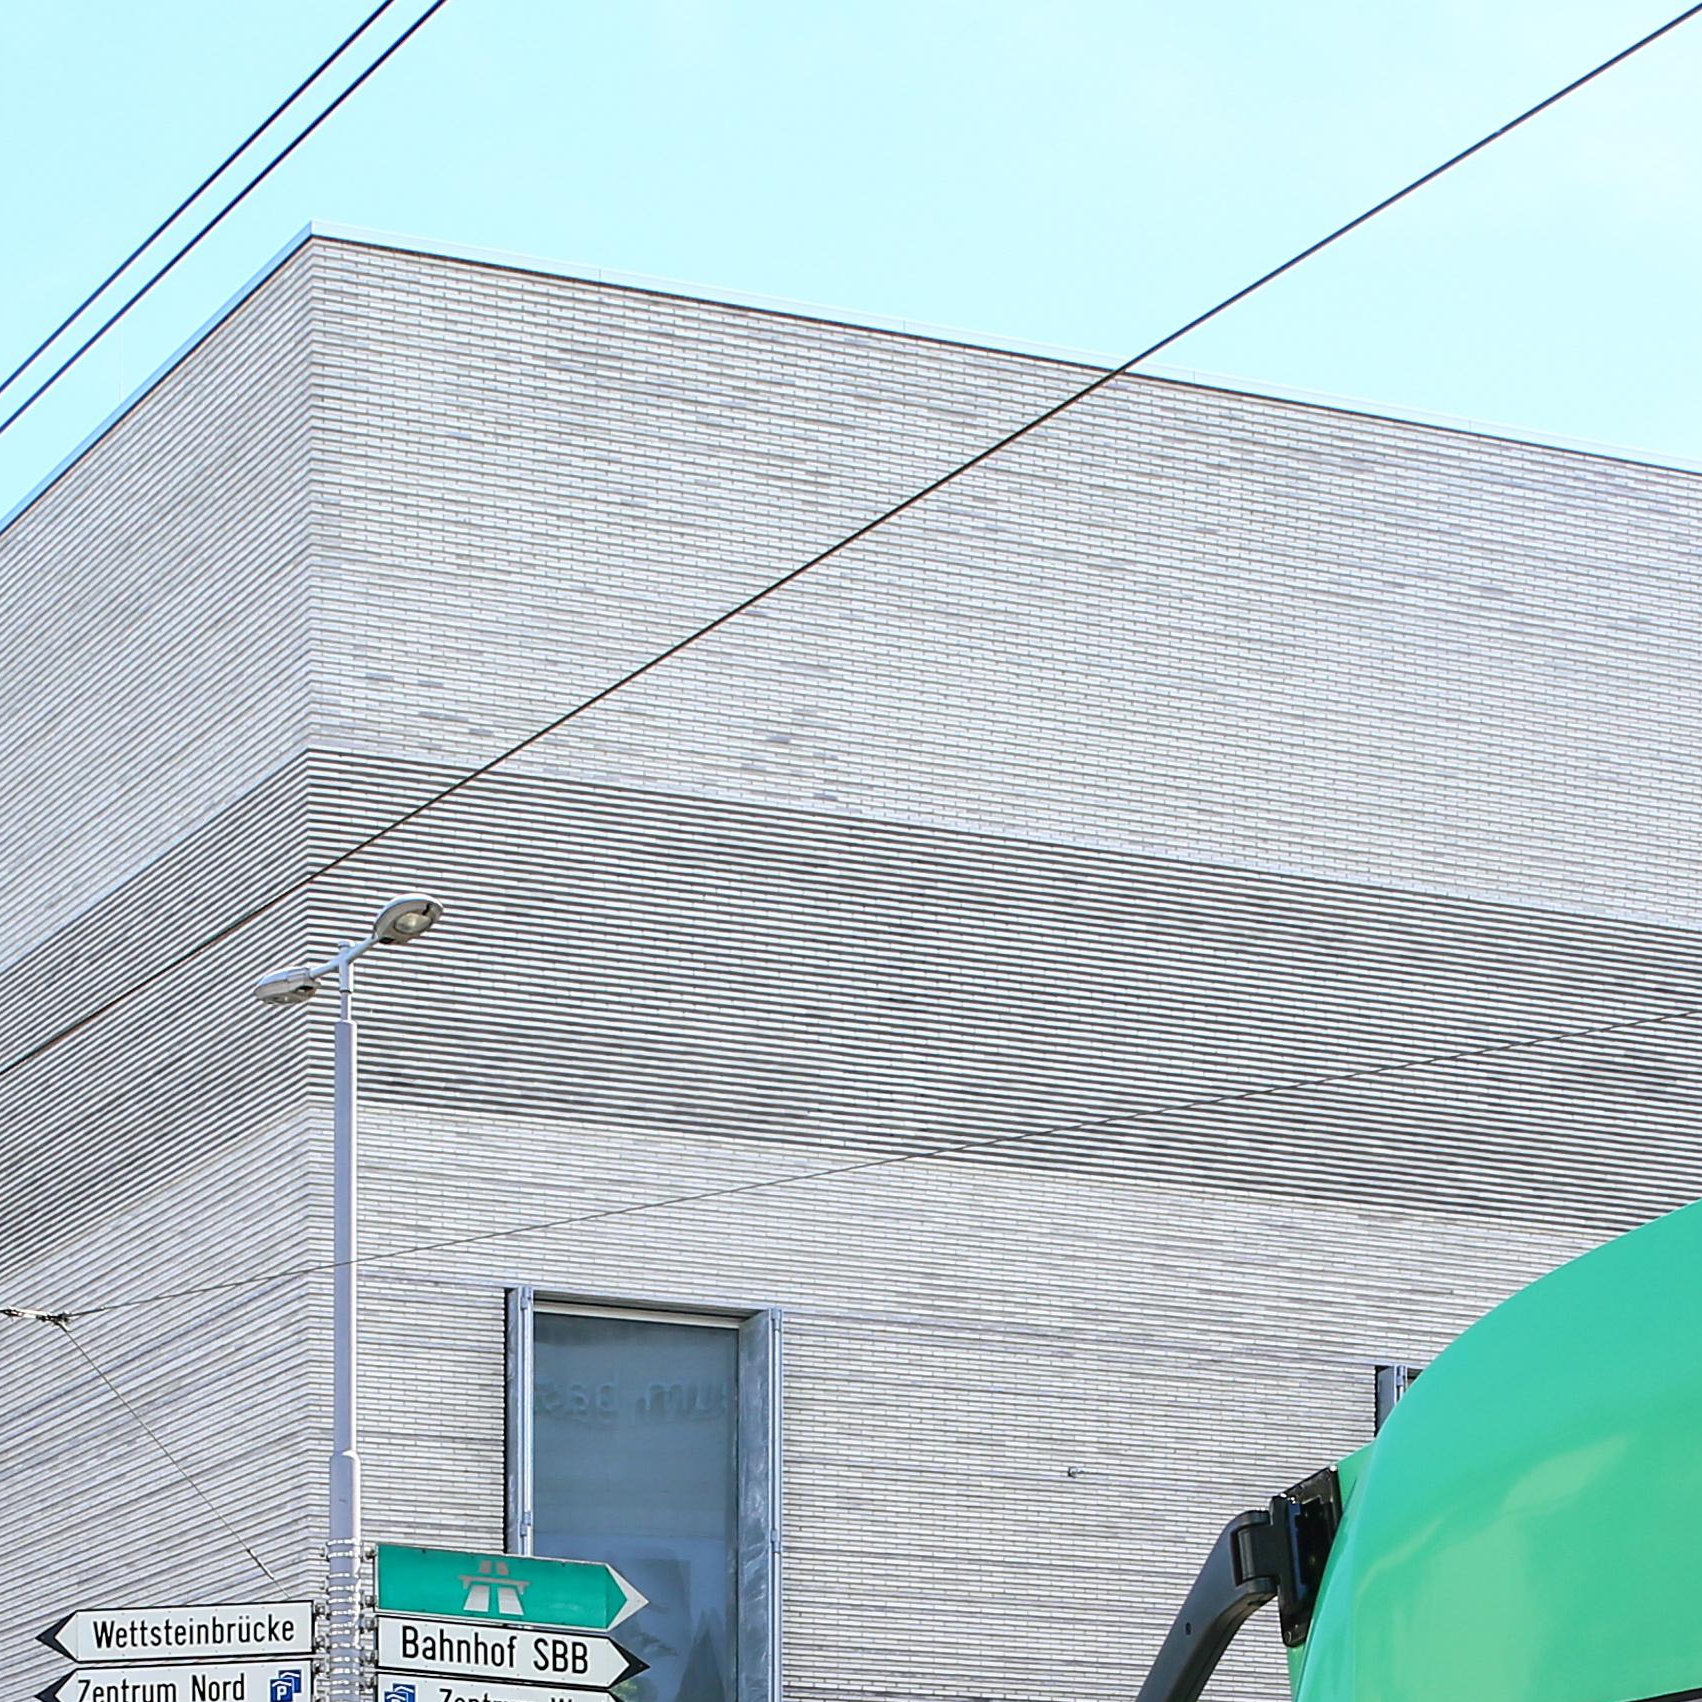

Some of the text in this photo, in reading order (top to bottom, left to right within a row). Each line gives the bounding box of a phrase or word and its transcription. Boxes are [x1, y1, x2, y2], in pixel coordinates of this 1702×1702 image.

[92, 1614, 295, 1649] Wettsteinbrücke
[401, 1625, 588, 1674] Bahnhof SBB
[191, 1672, 245, 1702] Nord
